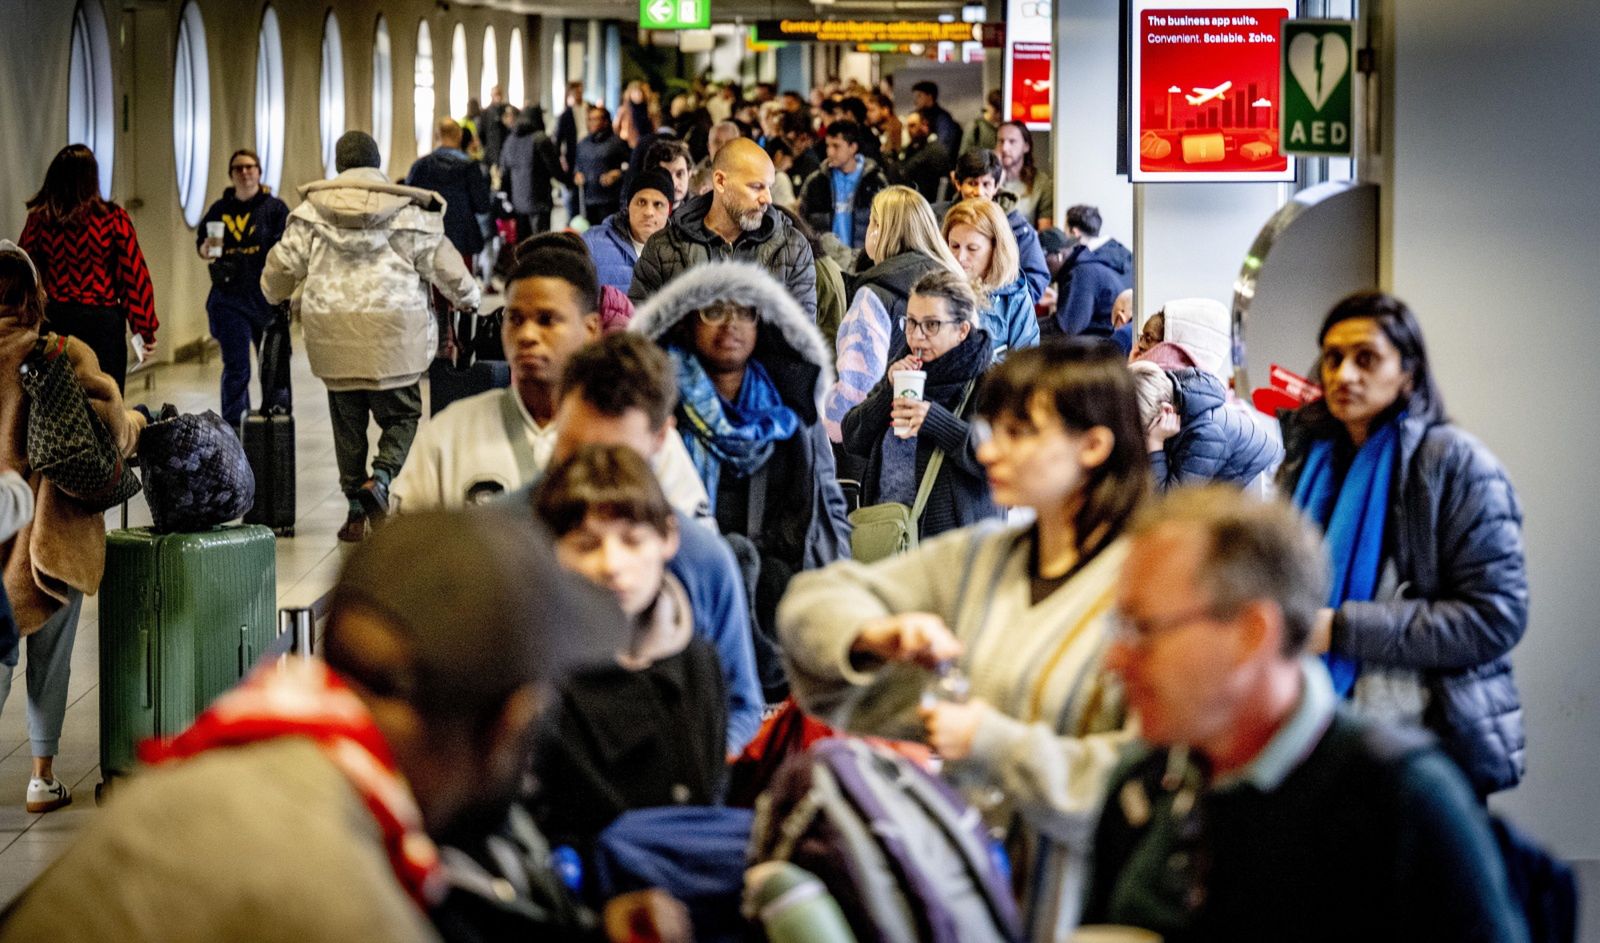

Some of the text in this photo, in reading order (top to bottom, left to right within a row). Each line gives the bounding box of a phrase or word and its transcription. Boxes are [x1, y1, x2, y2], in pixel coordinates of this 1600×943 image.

[1148, 15, 1258, 27] The business app suite.
[1147, 32, 1276, 44] Convenient. Scalable. Zoho.
[1290, 120, 1347, 145] AED
